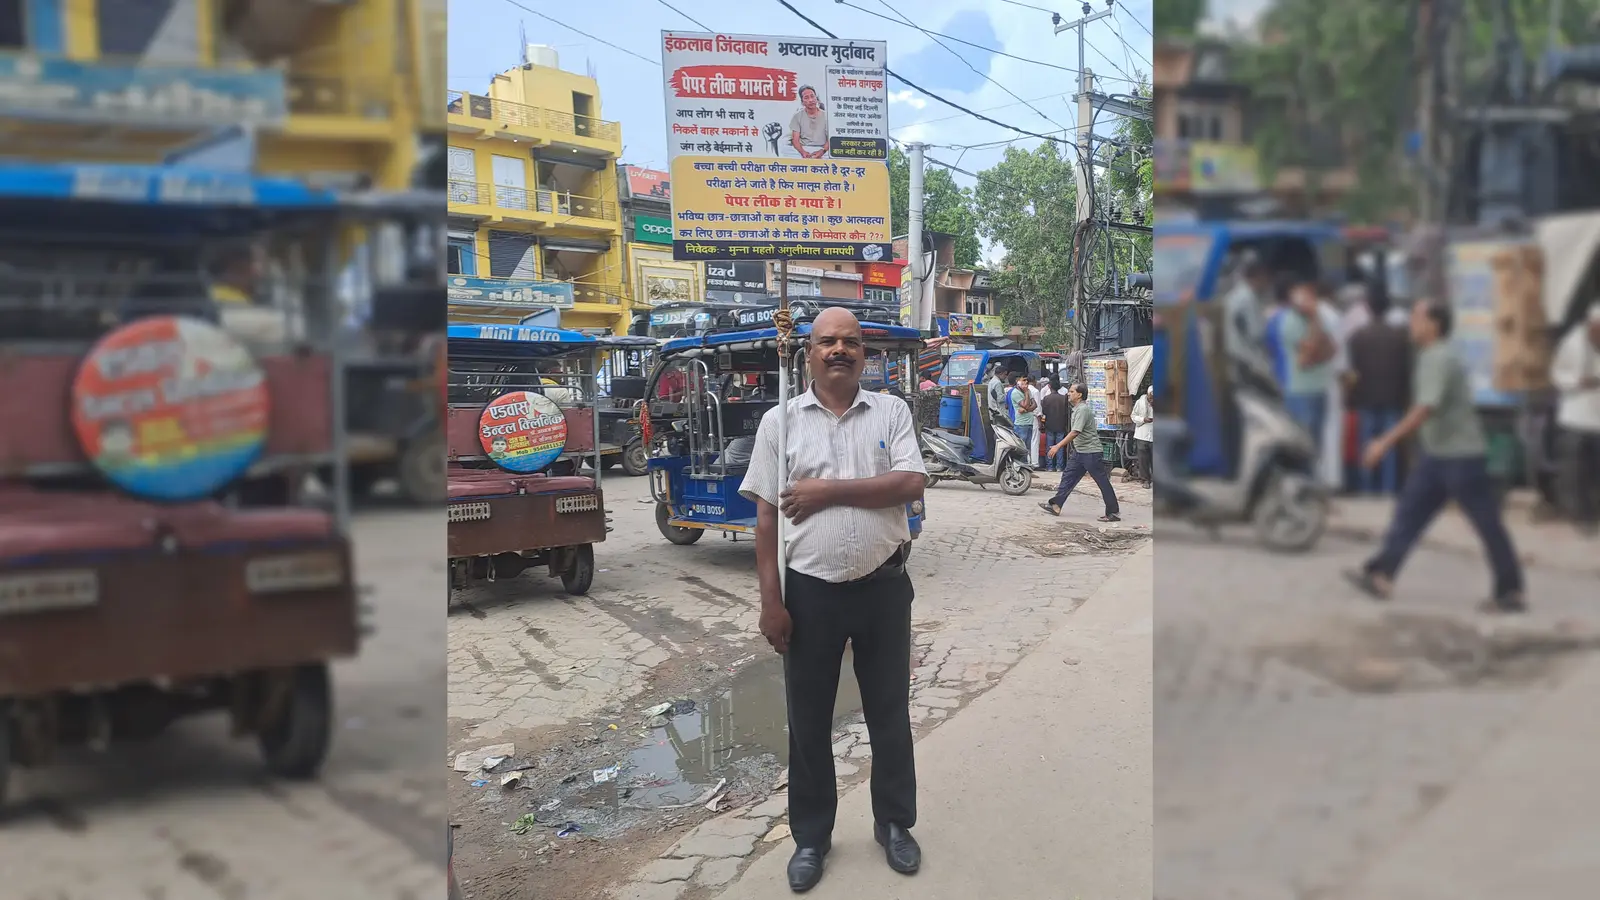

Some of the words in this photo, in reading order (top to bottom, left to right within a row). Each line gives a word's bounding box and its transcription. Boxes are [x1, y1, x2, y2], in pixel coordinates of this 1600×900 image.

[664, 33, 713, 53] इंकलाब
[715, 34, 768, 56] जिंदाबाद
[778, 42, 829, 58] भ्रष्टाचार
[831, 42, 875, 63] मुर्दाबाद
[681, 71, 706, 94] पेपर
[709, 72, 736, 95] लीक
[739, 74, 774, 97] मामले
[777, 75, 788, 97] में
[837, 76, 857, 88] सोनम
[676, 109, 693, 118] आप
[696, 107, 713, 119] लोग
[715, 108, 726, 119] भी
[729, 110, 745, 120] साथ
[672, 123, 698, 135] निकलें
[700, 126, 720, 136] बाहर
[722, 125, 749, 136] मकानों
[751, 126, 759, 137] से
[680, 140, 694, 151] जंग
[745, 142, 753, 153] से
[694, 162, 714, 171] बच्चा
[717, 160, 738, 171] बच्ची
[740, 161, 765, 172] परीक्षा
[768, 162, 787, 173] फीस
[790, 165, 807, 173] जमा
[810, 163, 829, 174] करते
[831, 163, 838, 175] है
[840, 166, 866, 177] दूर-दूर
[706, 177, 732, 188] परीक्षा
[734, 177, 747, 188] देने
[749, 178, 767, 189] जाते
[769, 178, 776, 190] है
[778, 179, 794, 190] फिर
[797, 181, 821, 192] मालूम
[823, 180, 841, 191] होता
[724, 193, 750, 206] पेपर
[752, 194, 781, 207] लीक
[783, 195, 797, 208] हो
[800, 198, 824, 208] गया
[678, 210, 704, 221] भविष्य
[764, 214, 775, 222] का
[778, 212, 799, 223] बर्बाद
[827, 215, 842, 225] कुछ
[845, 216, 884, 225] आत्महत्या
[679, 229, 693, 237] कर
[695, 226, 713, 239] लिए
[771, 228, 781, 239] के
[783, 228, 799, 239] मौत
[801, 228, 810, 239] के
[812, 228, 846, 240] जिम्मेवार
[849, 230, 866, 240] कौन
[728, 245, 750, 256] मुन्ना
[752, 244, 775, 254] महतो
[777, 244, 821, 256] अंगुलीमाल
[740, 313, 755, 324] BIG
[480, 326, 513, 340] Mini
[517, 328, 560, 341] Metro
[695, 504, 706, 514] BIG
[707, 505, 722, 516] BOSS
